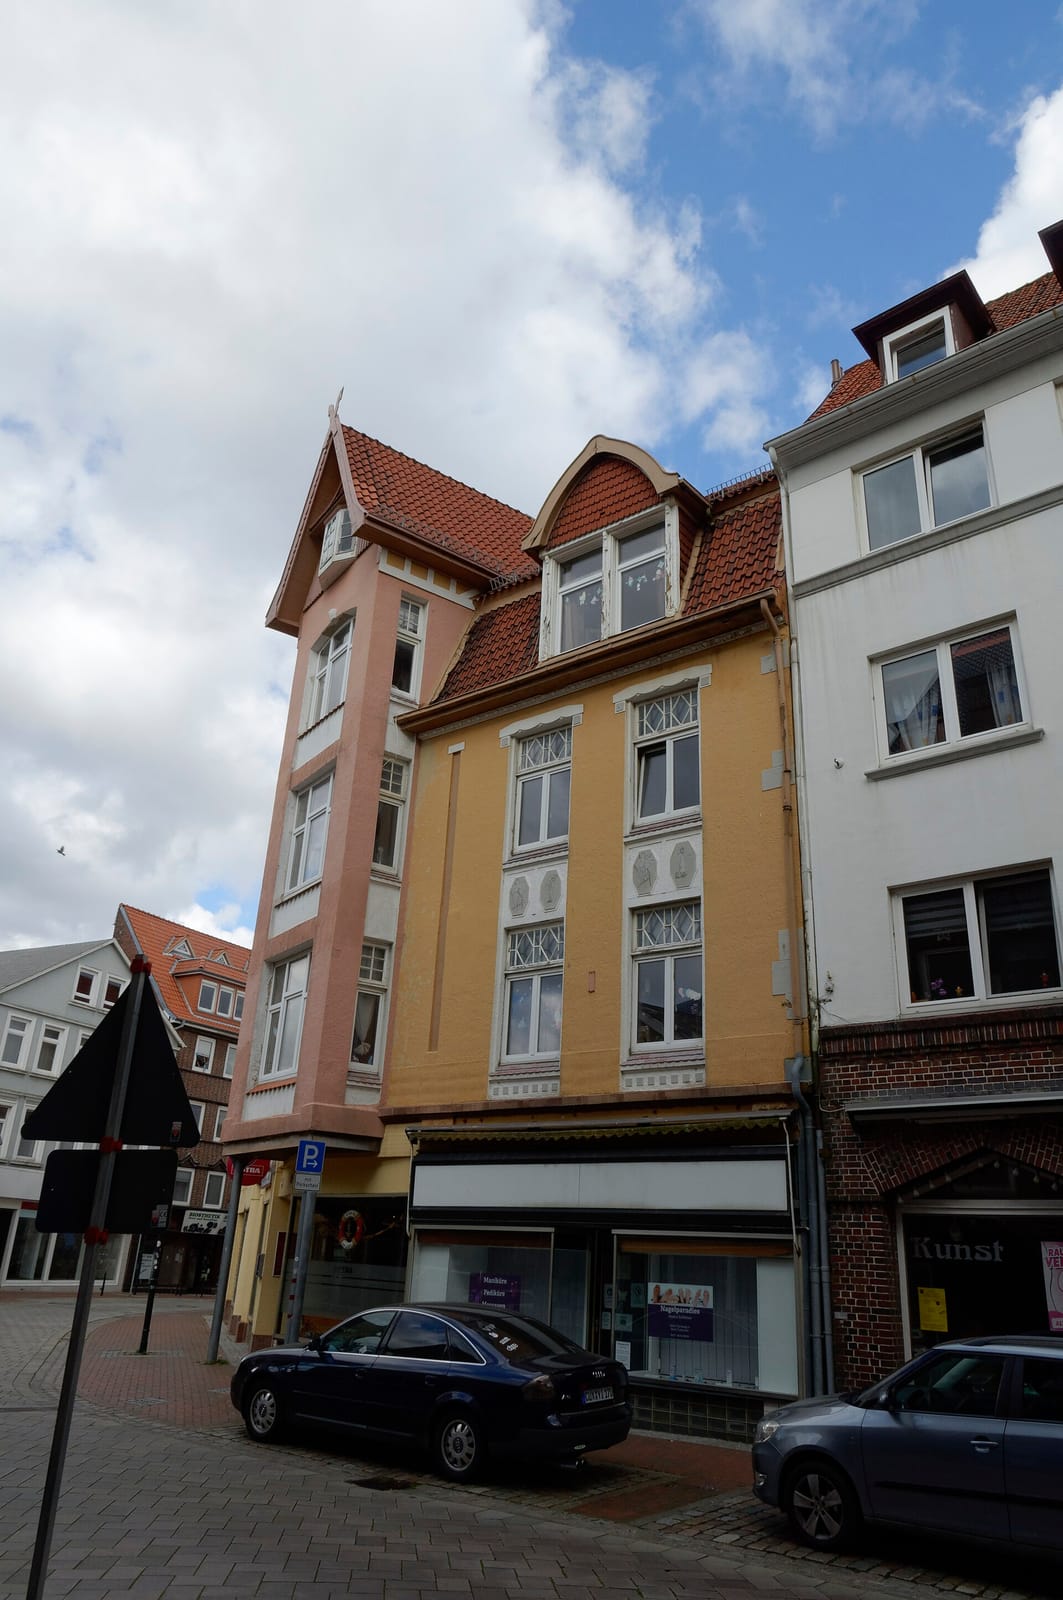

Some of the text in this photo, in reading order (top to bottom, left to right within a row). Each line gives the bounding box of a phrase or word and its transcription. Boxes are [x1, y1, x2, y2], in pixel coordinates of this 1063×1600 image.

[303, 1144, 319, 1168] P
[910, 1236, 1004, 1262] Kunst
[660, 1305, 701, 1315] Nagelparadies
